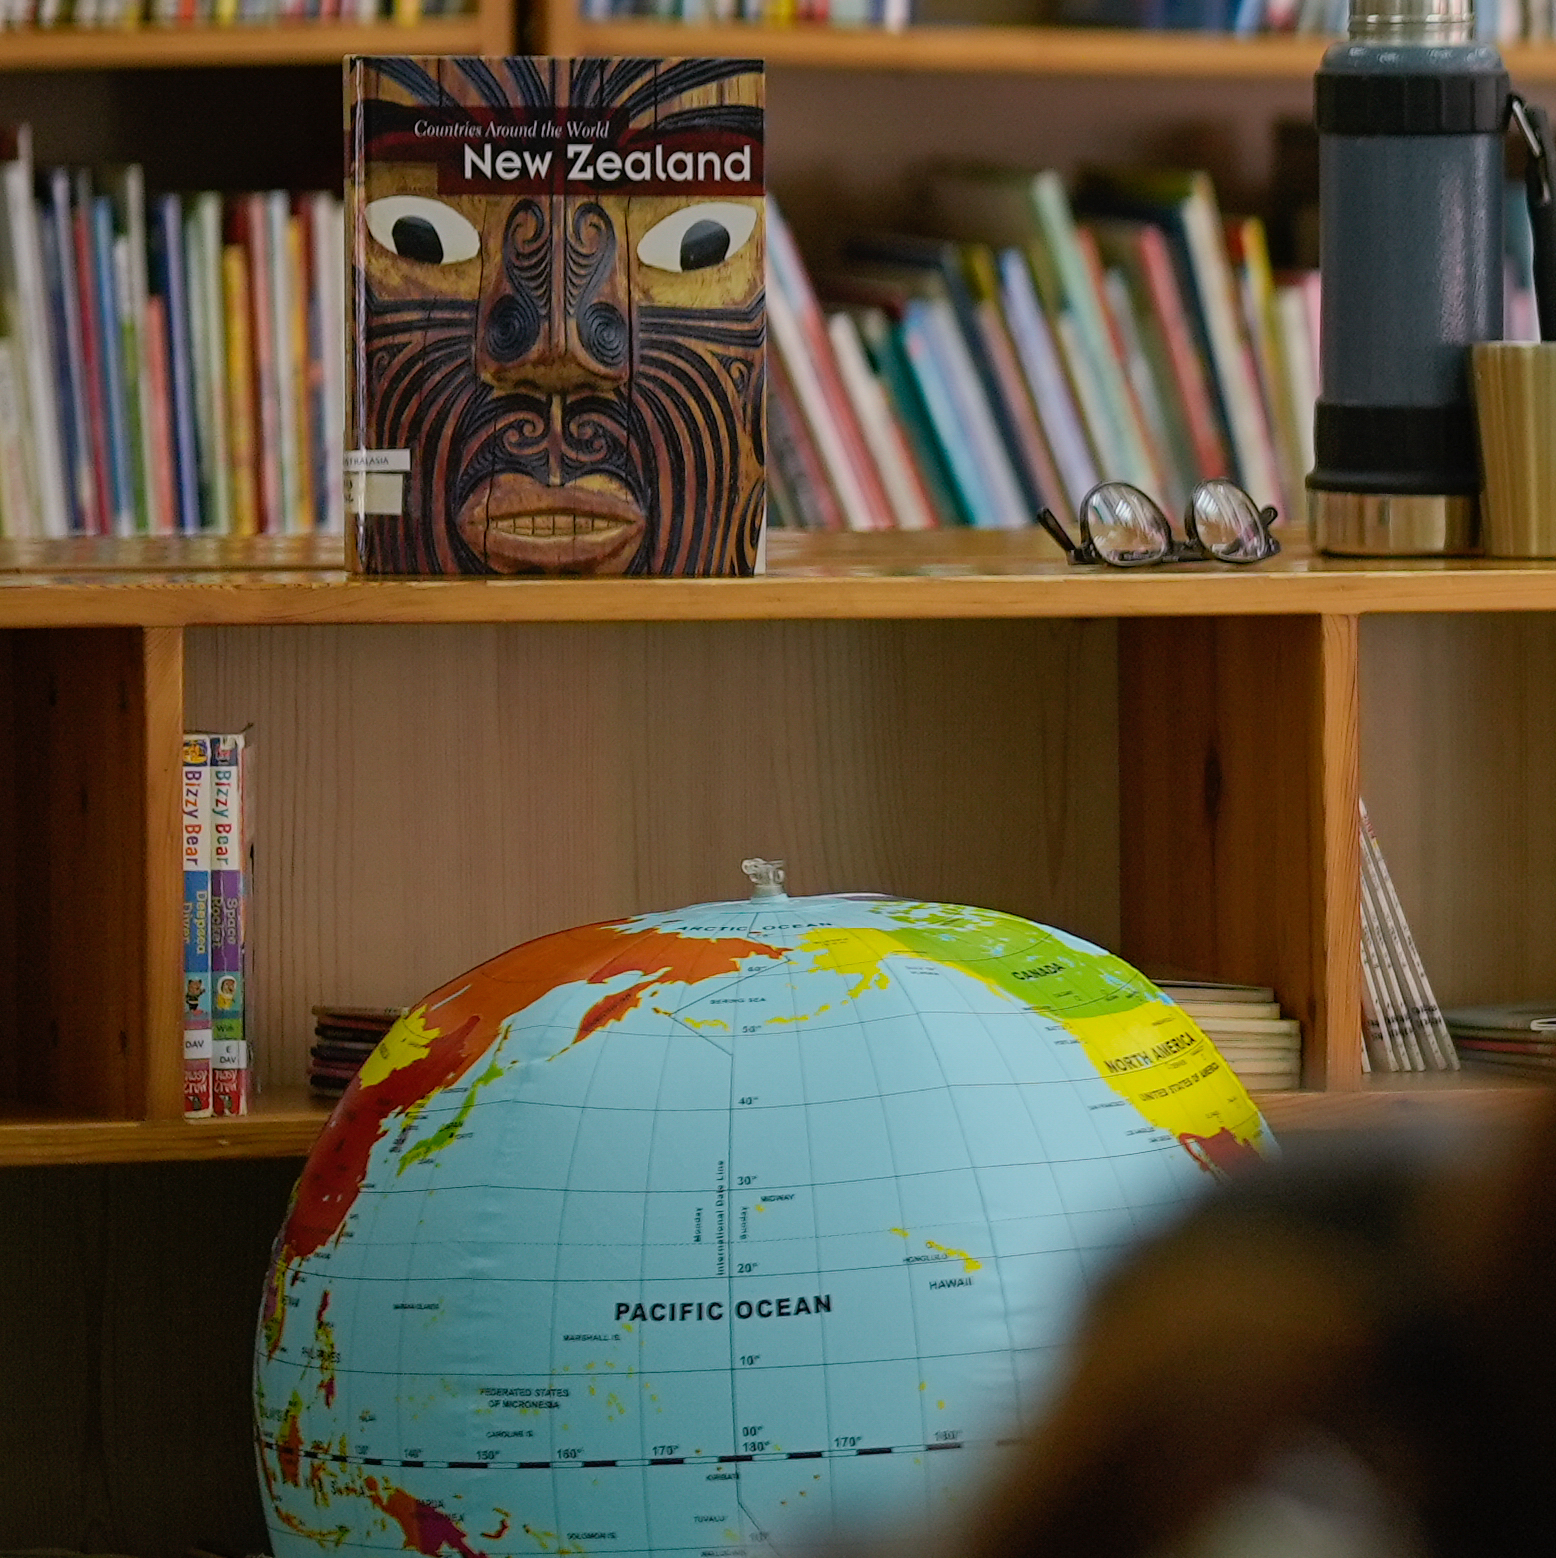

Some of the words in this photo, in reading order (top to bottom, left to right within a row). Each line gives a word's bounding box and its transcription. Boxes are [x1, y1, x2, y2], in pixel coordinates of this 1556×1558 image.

[414, 119, 482, 139] Countries
[485, 119, 538, 139] Around
[540, 120, 563, 139] the
[566, 120, 610, 139] World
[464, 143, 552, 181] New
[566, 143, 750, 181] Zealand
[182, 770, 203, 819] Bizzy
[212, 769, 232, 818] Bizzy
[184, 824, 203, 866] Bear
[214, 823, 233, 866] Bear
[226, 897, 239, 945] Space
[770, 922, 833, 931] OCEAN
[1011, 961, 1066, 982] CANADA
[185, 1040, 204, 1049] DAV
[1103, 1049, 1152, 1074] NORTH
[1152, 1031, 1198, 1063] AMERICA
[716, 1160, 725, 1181] Line
[737, 1175, 758, 1185] 30°
[694, 1207, 703, 1243] Monday
[737, 1263, 758, 1273] 20°
[928, 1276, 974, 1291] HAWAII
[614, 1301, 724, 1322] PACIFIC
[735, 1294, 833, 1321] OCEAN
[740, 1354, 760, 1365] 10°
